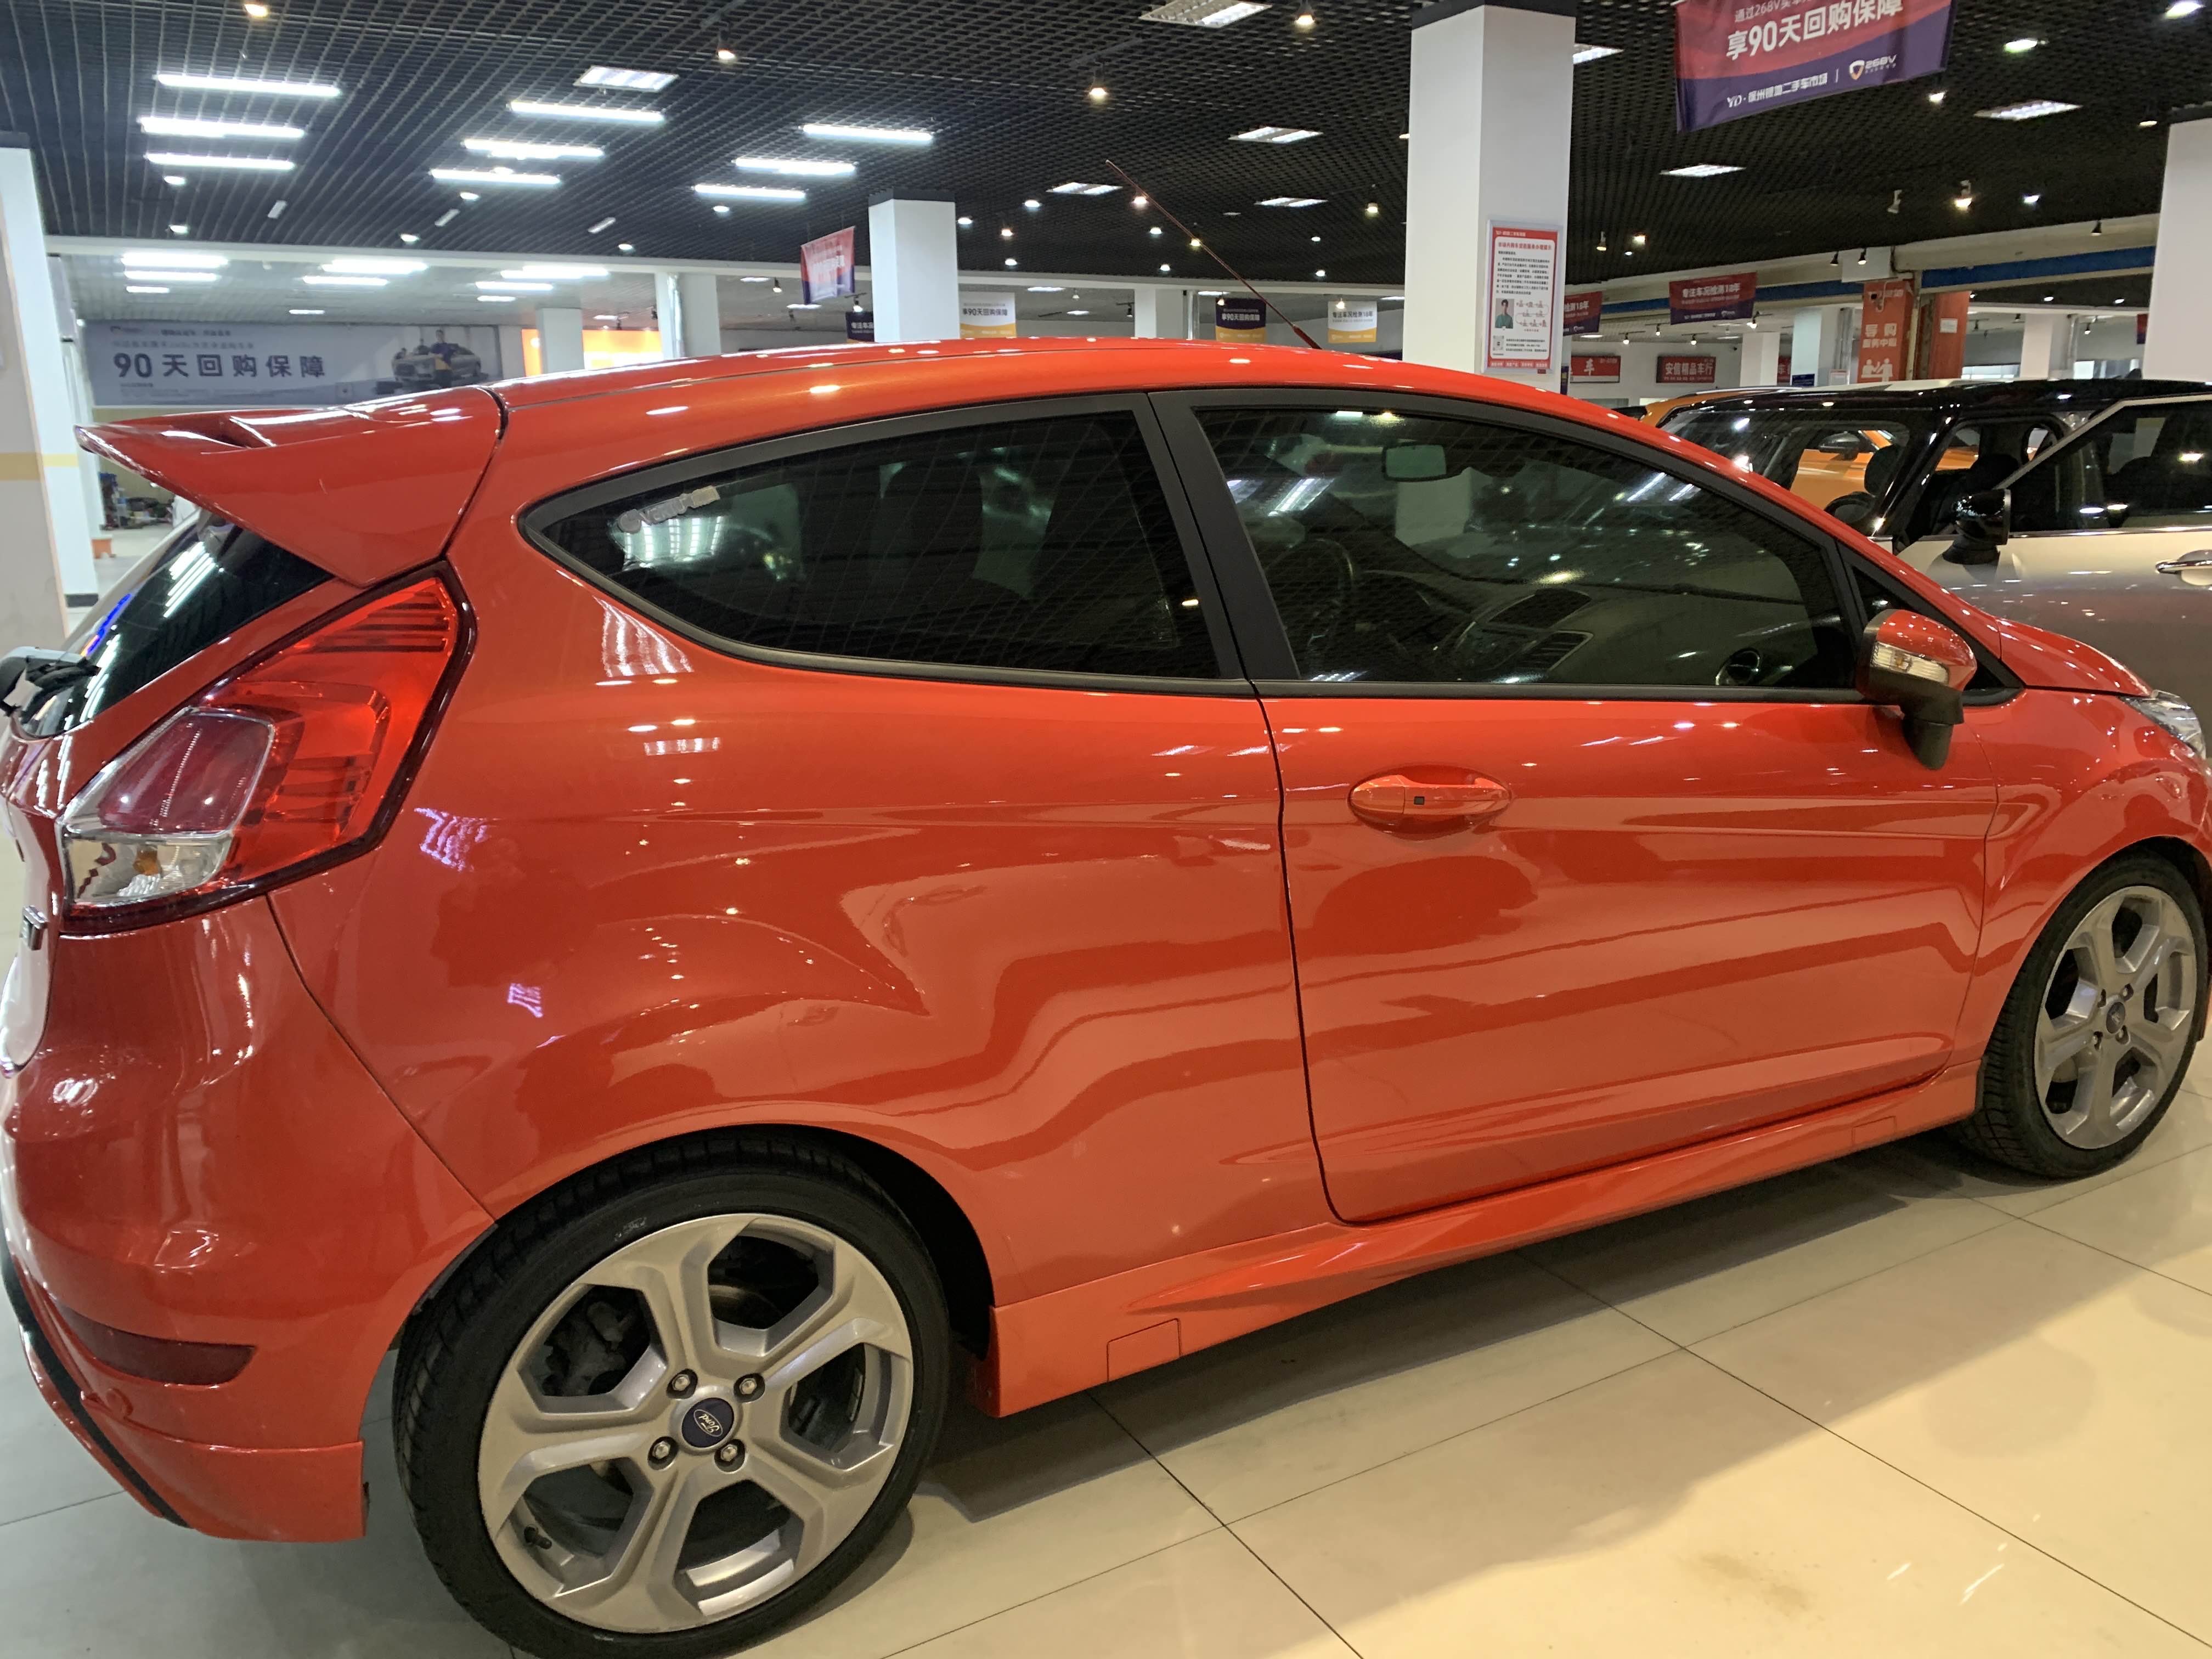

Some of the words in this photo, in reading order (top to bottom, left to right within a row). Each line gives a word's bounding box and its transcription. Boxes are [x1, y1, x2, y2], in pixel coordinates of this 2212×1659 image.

[1726, 0, 1903, 60] 享90天回购保障
[113, 352, 325, 379] 90天回购保障
[698, 1414, 719, 1433] Ford
